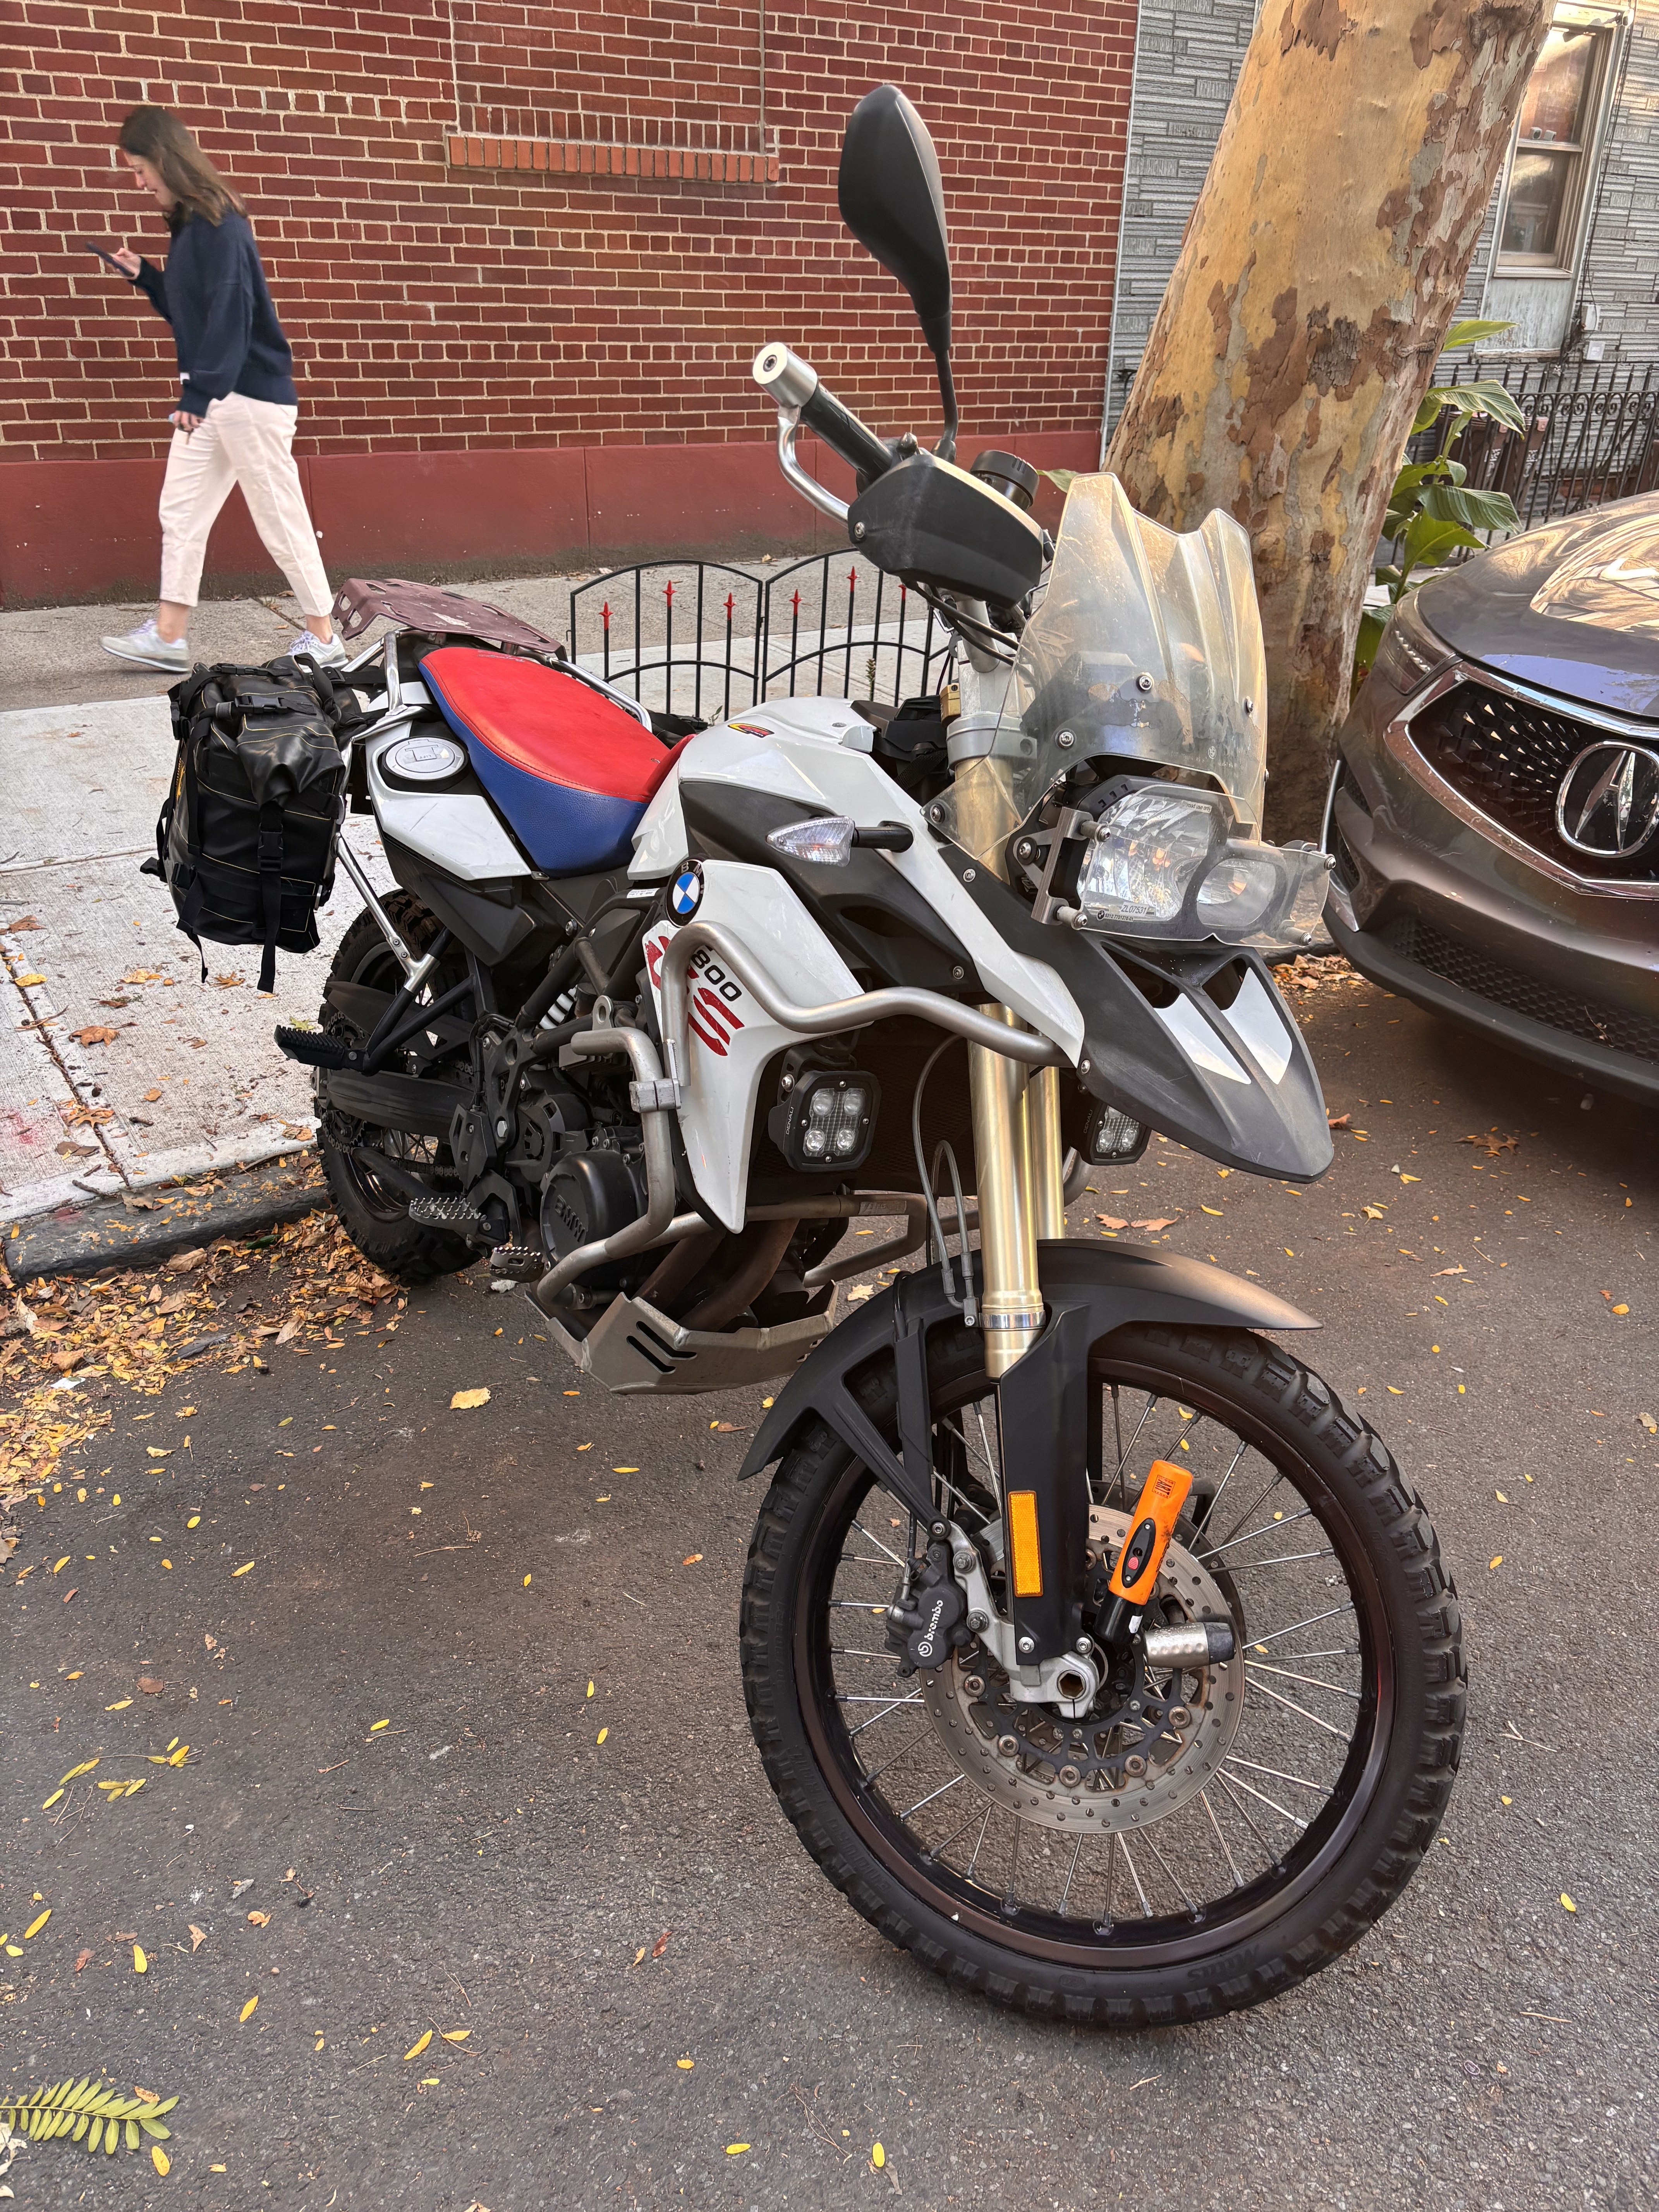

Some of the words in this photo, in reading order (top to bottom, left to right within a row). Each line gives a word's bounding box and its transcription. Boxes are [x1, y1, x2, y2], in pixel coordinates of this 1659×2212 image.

[1121, 905, 1147, 914] ZL07531
[786, 1106, 794, 1135] DENALI
[1083, 1109, 1093, 1134] DENALI
[555, 1194, 586, 1243] BMW
[924, 1600, 943, 1641] brembo
